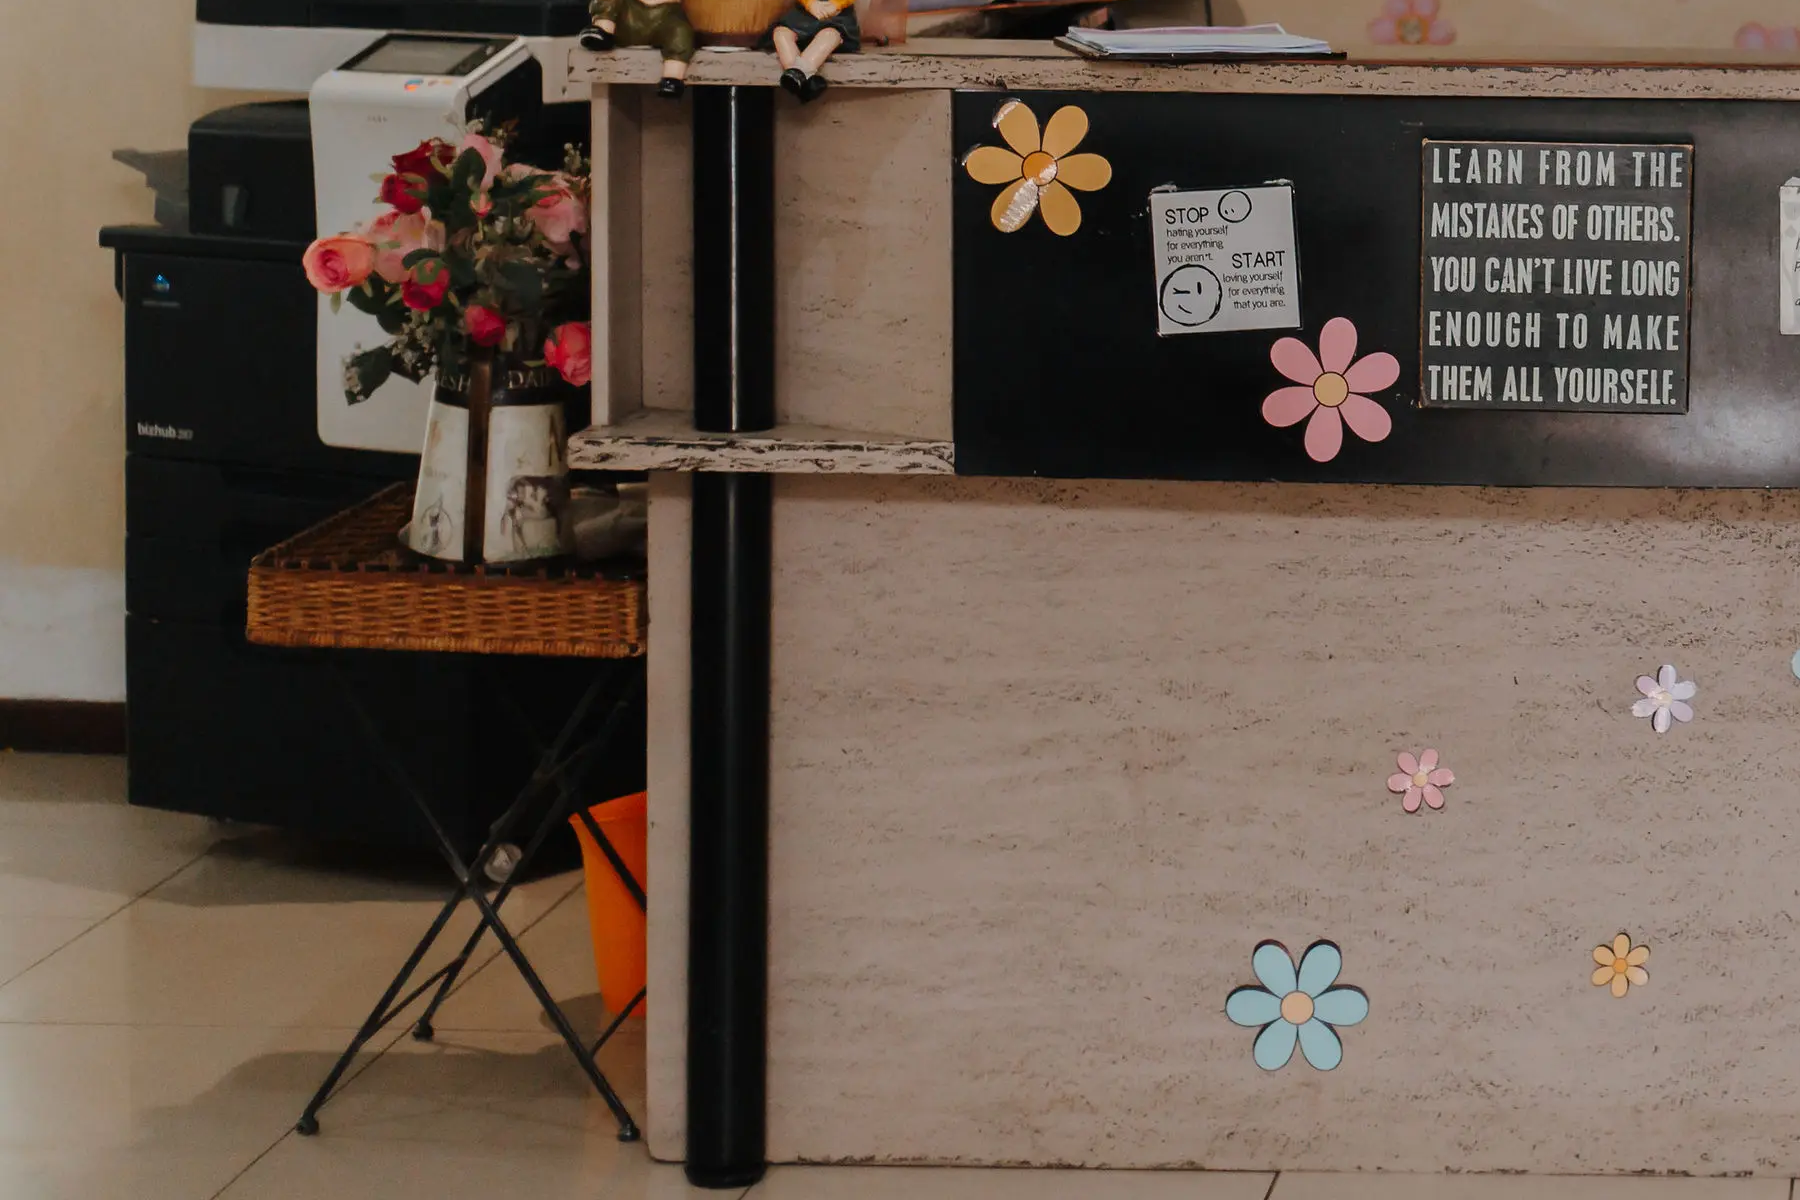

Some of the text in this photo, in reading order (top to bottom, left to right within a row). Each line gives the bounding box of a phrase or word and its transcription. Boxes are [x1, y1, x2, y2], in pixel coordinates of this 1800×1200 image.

[1432, 148, 1683, 187] LEARN FROM THE
[1165, 207, 1209, 225] STOP
[1431, 202, 1680, 242] MISTAKES OF OTHERS.
[1166, 225, 1228, 238] hating yourself
[1166, 239, 1224, 252] for everything
[1167, 255, 1183, 265] you
[1232, 251, 1285, 269] START
[1223, 270, 1283, 284] loving yourself
[1431, 256, 1680, 296] YOU CAN'T LIVE LONG
[1228, 284, 1285, 298] for everything
[1233, 299, 1251, 310] that
[1252, 301, 1268, 311] you
[1428, 311, 1680, 351] ENOUGH TO MAKE
[1428, 365, 1676, 405] THEM ALL YOURSELF.
